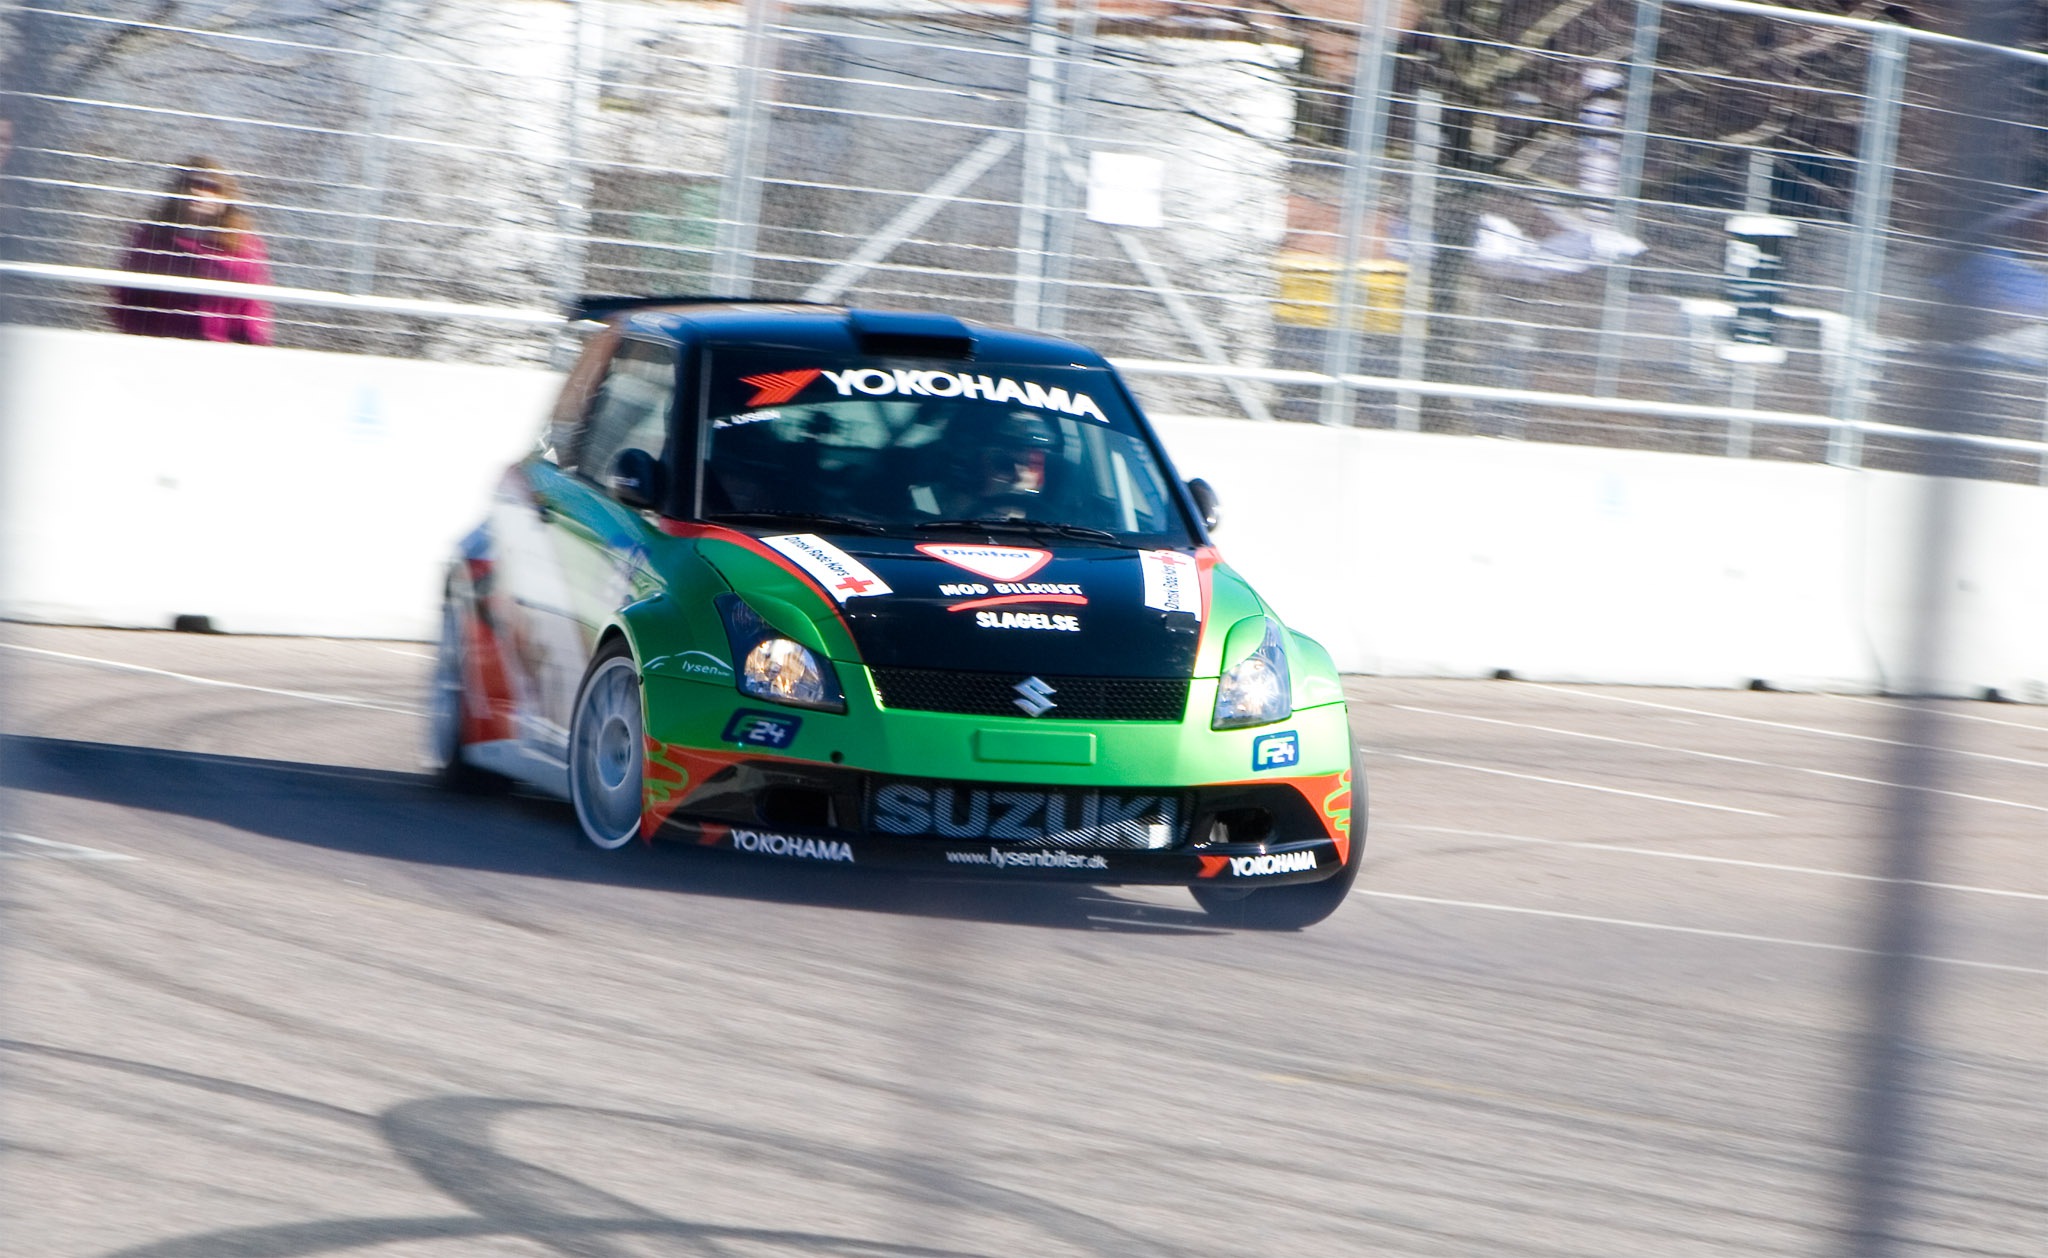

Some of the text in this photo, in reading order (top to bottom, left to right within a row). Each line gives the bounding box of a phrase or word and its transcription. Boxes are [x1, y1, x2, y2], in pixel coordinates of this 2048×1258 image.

[821, 368, 1110, 424] YOKOHAMA
[941, 548, 1031, 560] Dinitrol
[938, 583, 1083, 596] MOD BILRUST
[975, 611, 1081, 632] SLAGELSE
[682, 660, 718, 675] lysen
[874, 784, 1178, 850] SUZUKI
[730, 828, 855, 863] YOKOHAMA
[945, 846, 1109, 869] www.lysenbiler.dk
[1229, 850, 1318, 877] YOKOHAMA
